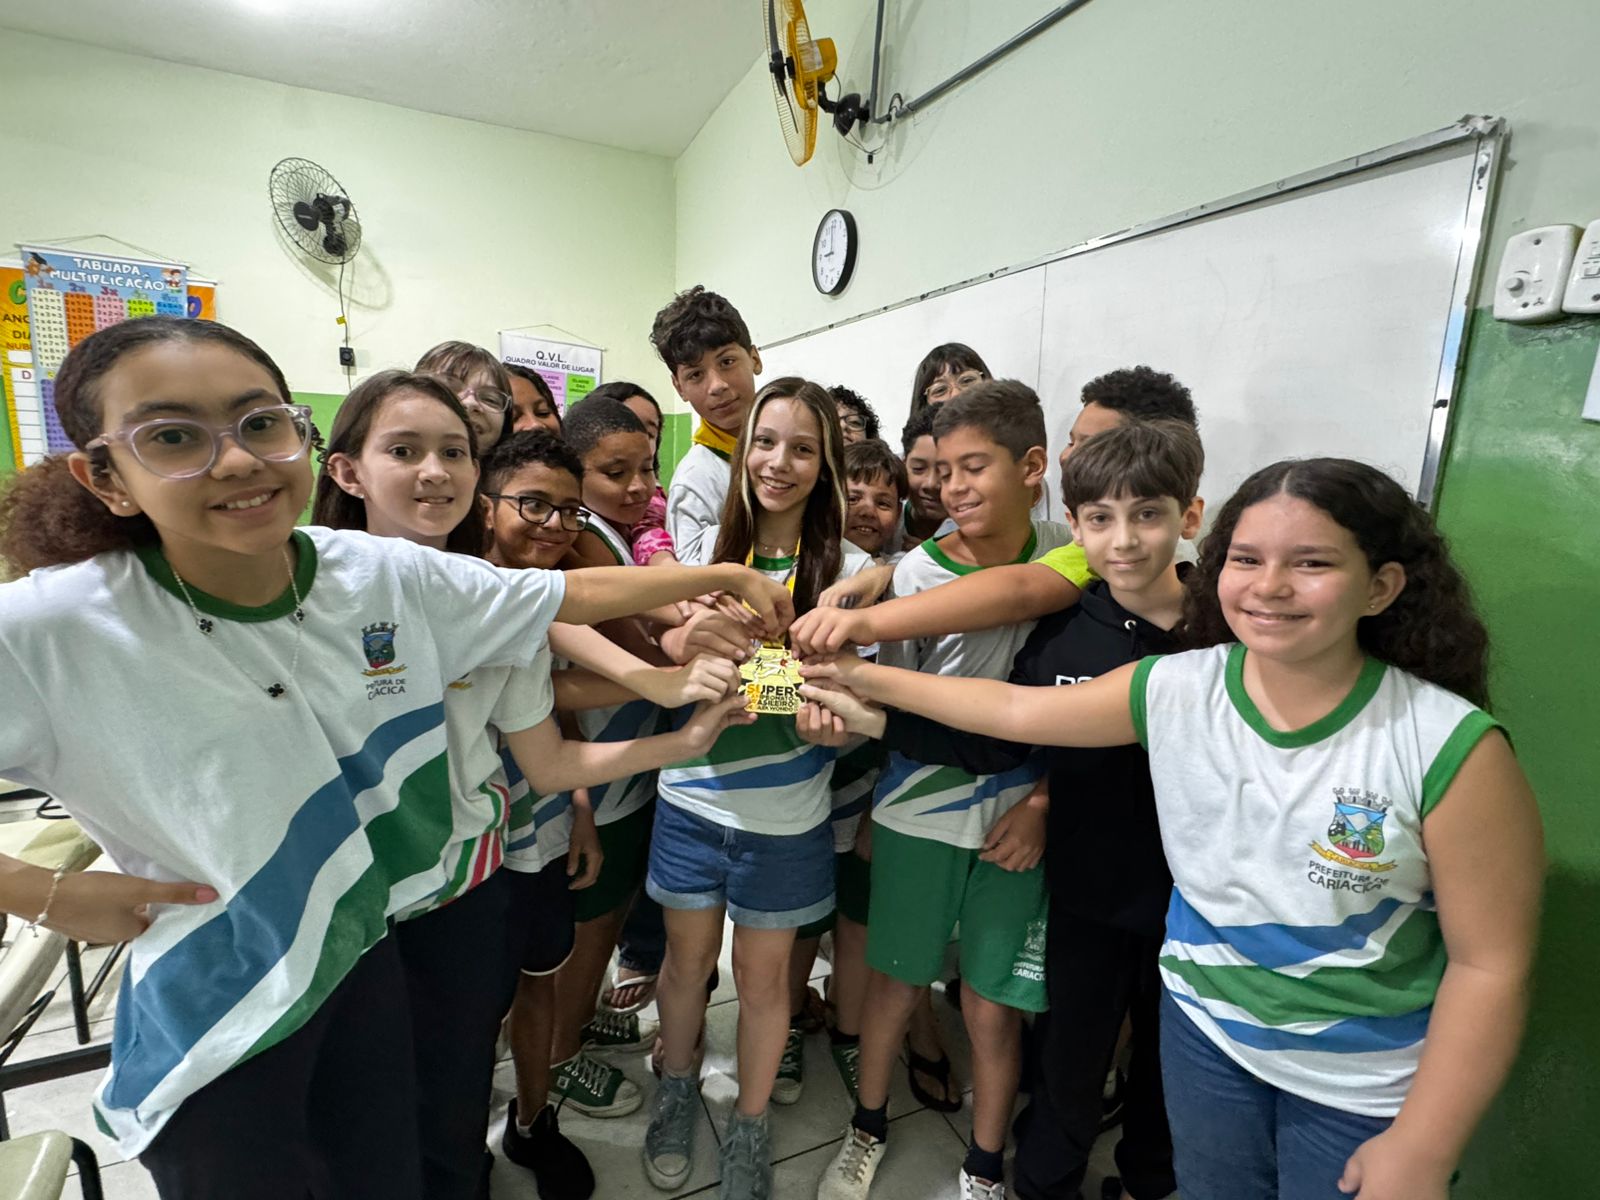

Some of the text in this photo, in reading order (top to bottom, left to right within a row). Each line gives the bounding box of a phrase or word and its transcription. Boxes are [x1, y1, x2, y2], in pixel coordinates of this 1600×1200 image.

[73, 258, 140, 275] TABUADA
[101, 286, 118, 296] 3x
[506, 356, 536, 365] QUADRO
[538, 361, 560, 369] VALOR
[572, 365, 595, 373] LUGAR
[22, 371, 32, 380] D
[747, 684, 794, 696] SUPER
[1309, 860, 1371, 882] PREFEITURA
